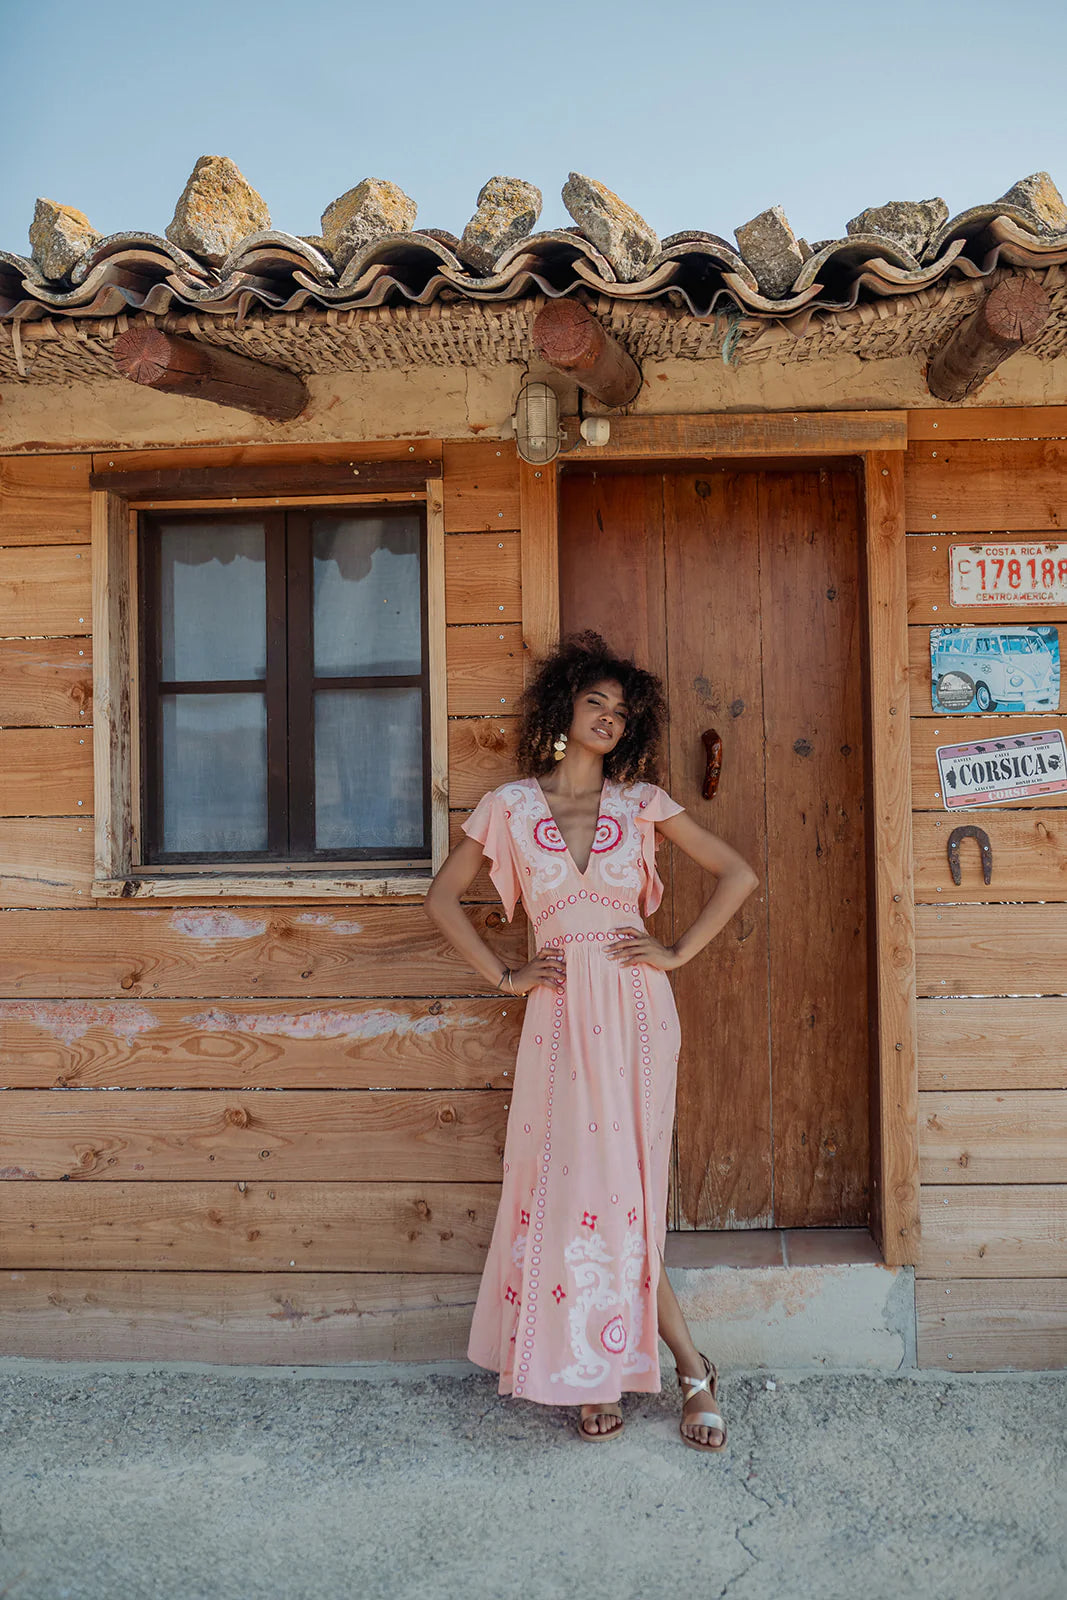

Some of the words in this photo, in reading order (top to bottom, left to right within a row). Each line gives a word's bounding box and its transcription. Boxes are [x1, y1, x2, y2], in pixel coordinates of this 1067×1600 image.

[985, 547, 1016, 556] COSTA
[1021, 547, 1042, 556] RICA
[976, 592, 1054, 602] CENTROAMERICA
[959, 753, 1048, 786] CORSICA
[988, 787, 1028, 801] CORSE
